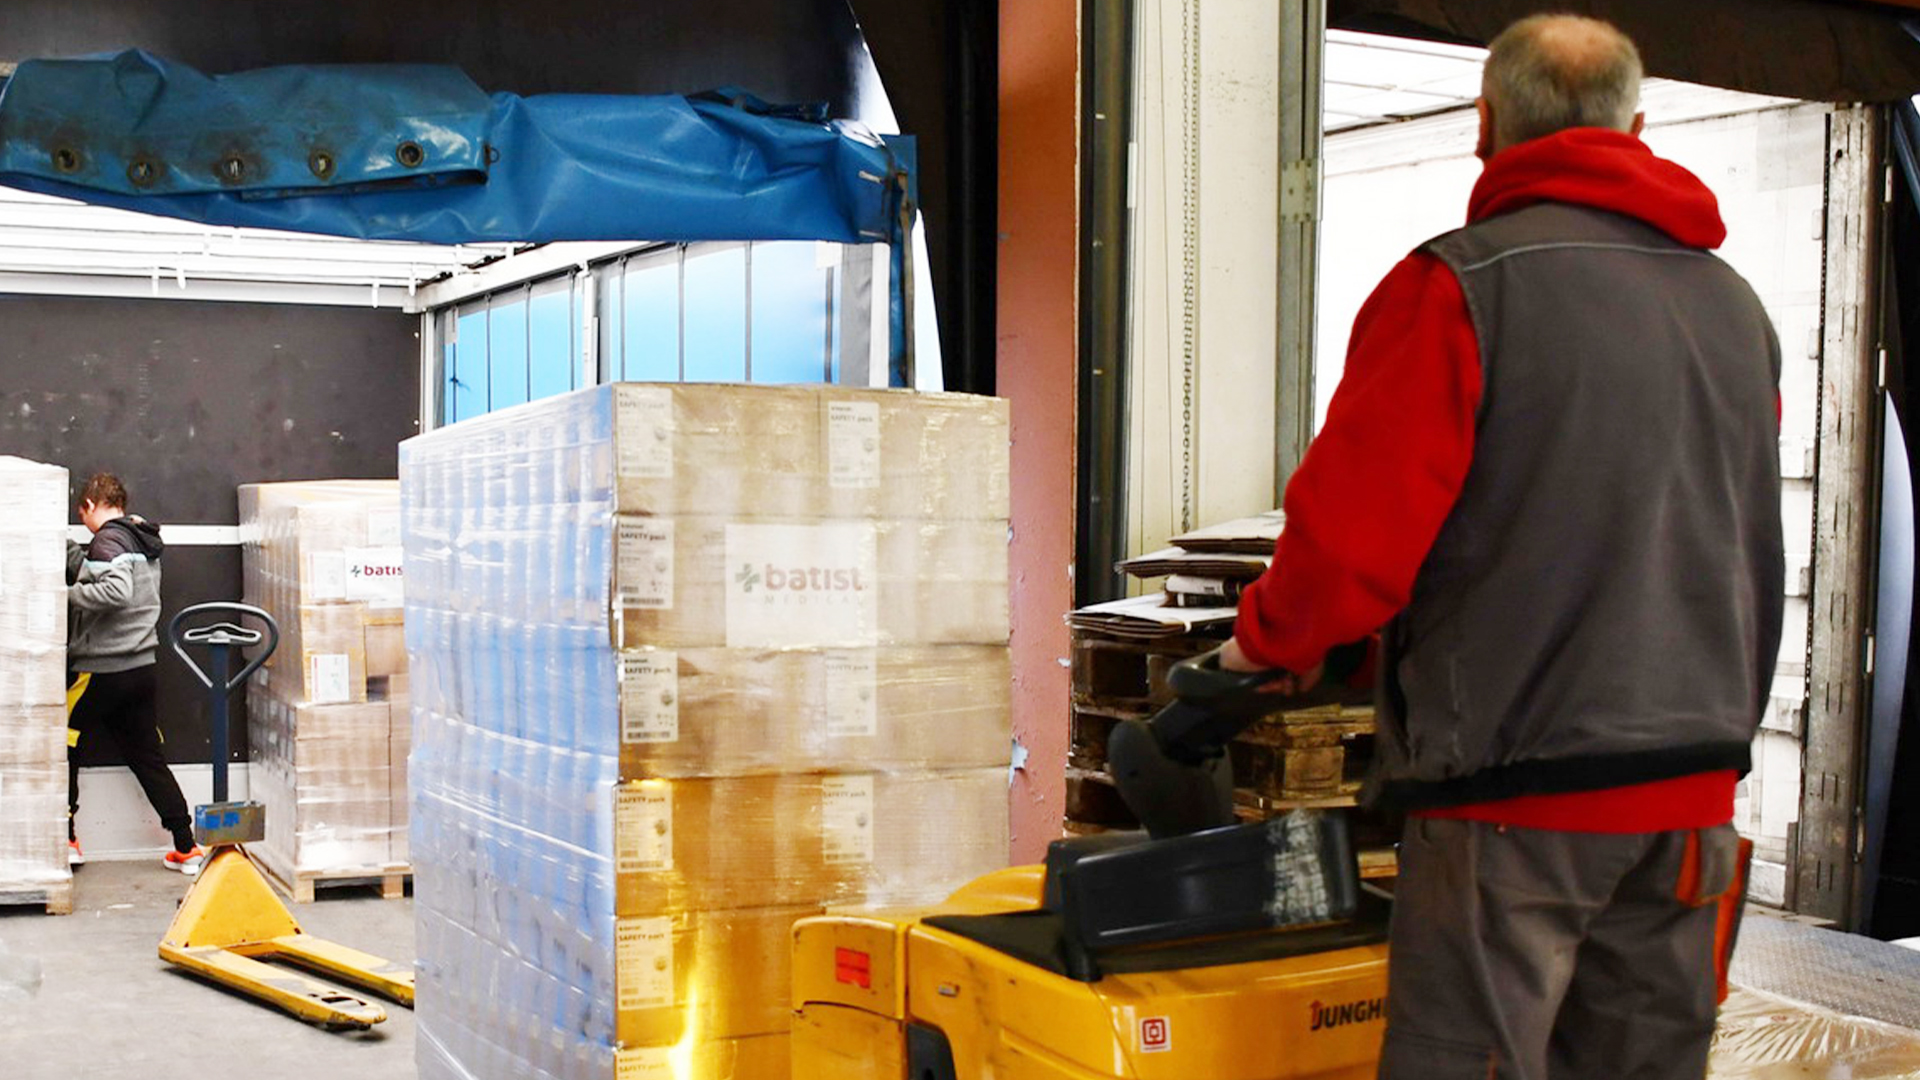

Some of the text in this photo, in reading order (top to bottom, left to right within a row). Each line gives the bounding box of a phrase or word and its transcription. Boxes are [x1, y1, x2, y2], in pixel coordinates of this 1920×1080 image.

[765, 563, 863, 591] batist
[624, 666, 652, 674] SAFETY
[618, 796, 646, 804] SAFETY
[619, 933, 646, 941] SAFETY
[1311, 998, 1389, 1031] JUNGH
